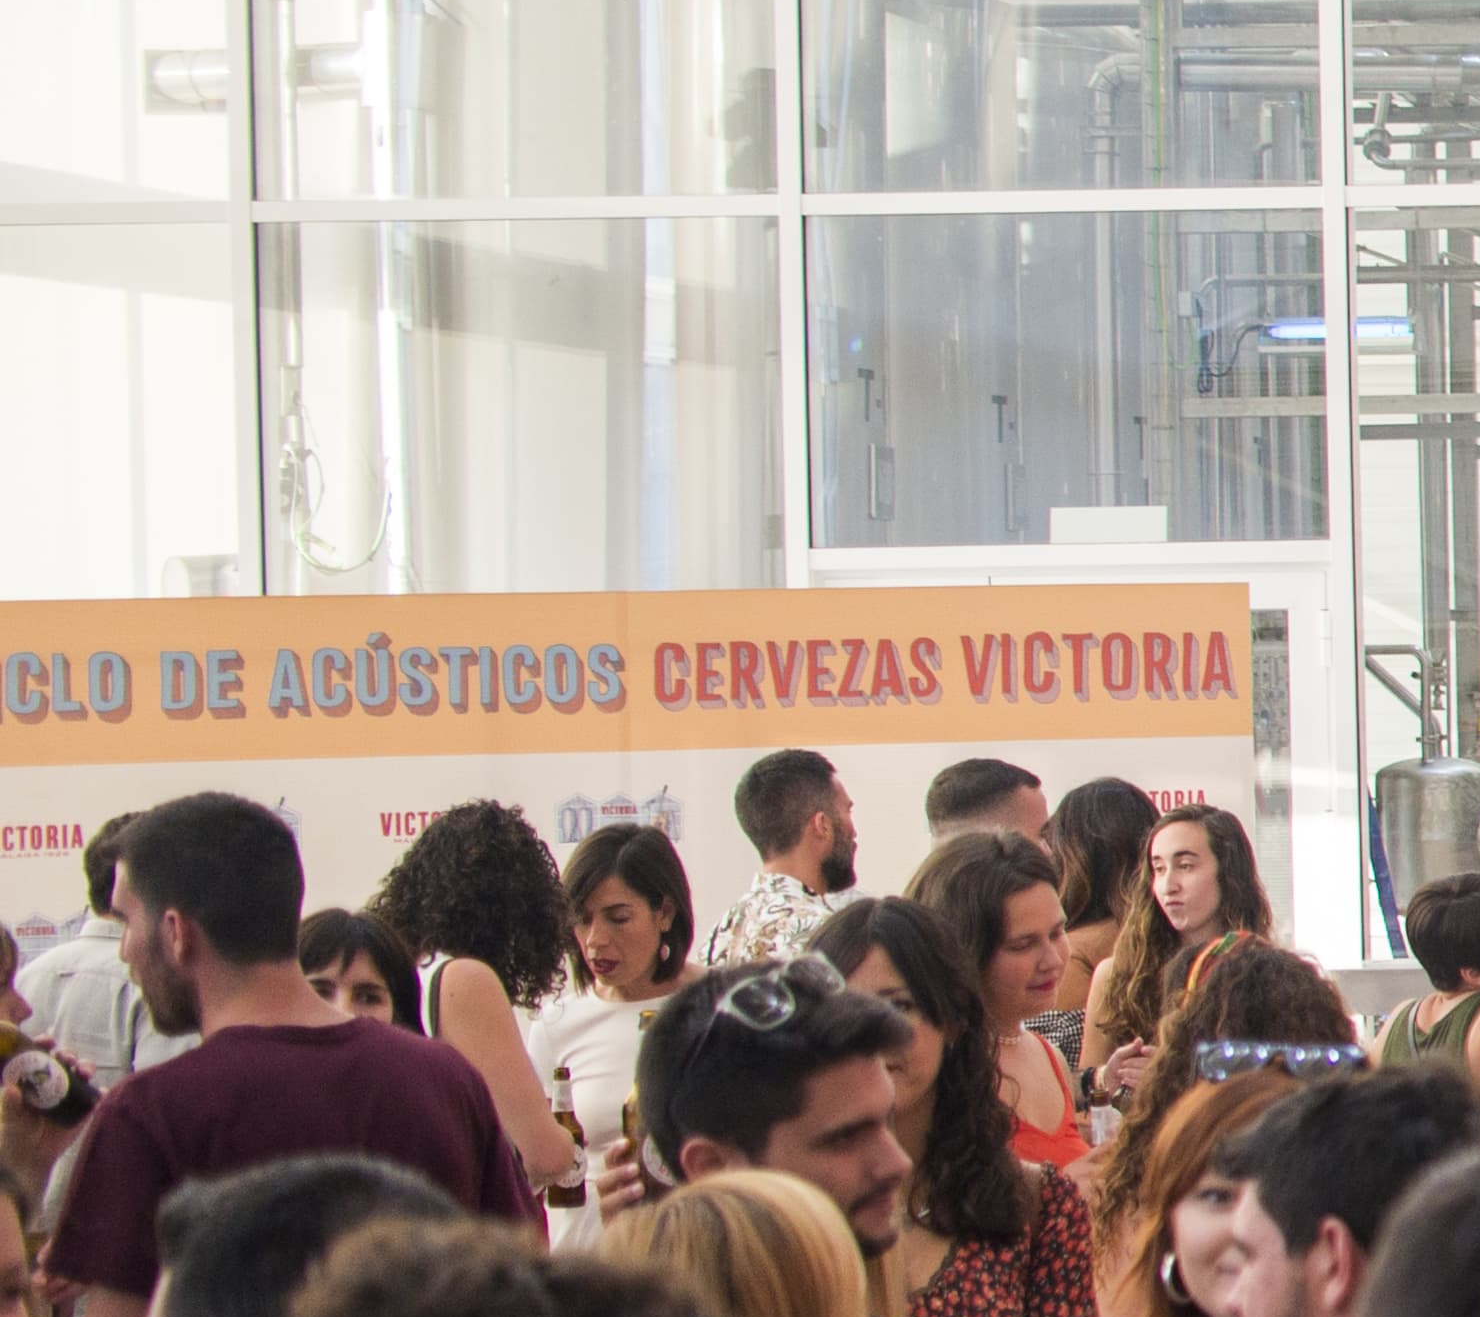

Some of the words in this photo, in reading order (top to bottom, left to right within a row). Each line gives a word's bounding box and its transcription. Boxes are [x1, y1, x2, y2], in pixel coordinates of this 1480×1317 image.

[0, 650, 132, 723] CLO
[160, 649, 246, 720] DE
[268, 631, 628, 717] ACÚSTICOS
[654, 636, 943, 712] CERVEZAS
[960, 631, 1238, 704] VICTORIA
[1148, 789, 1206, 813] TORIA
[380, 811, 442, 837] VICT
[2, 824, 84, 852] CTORIA
